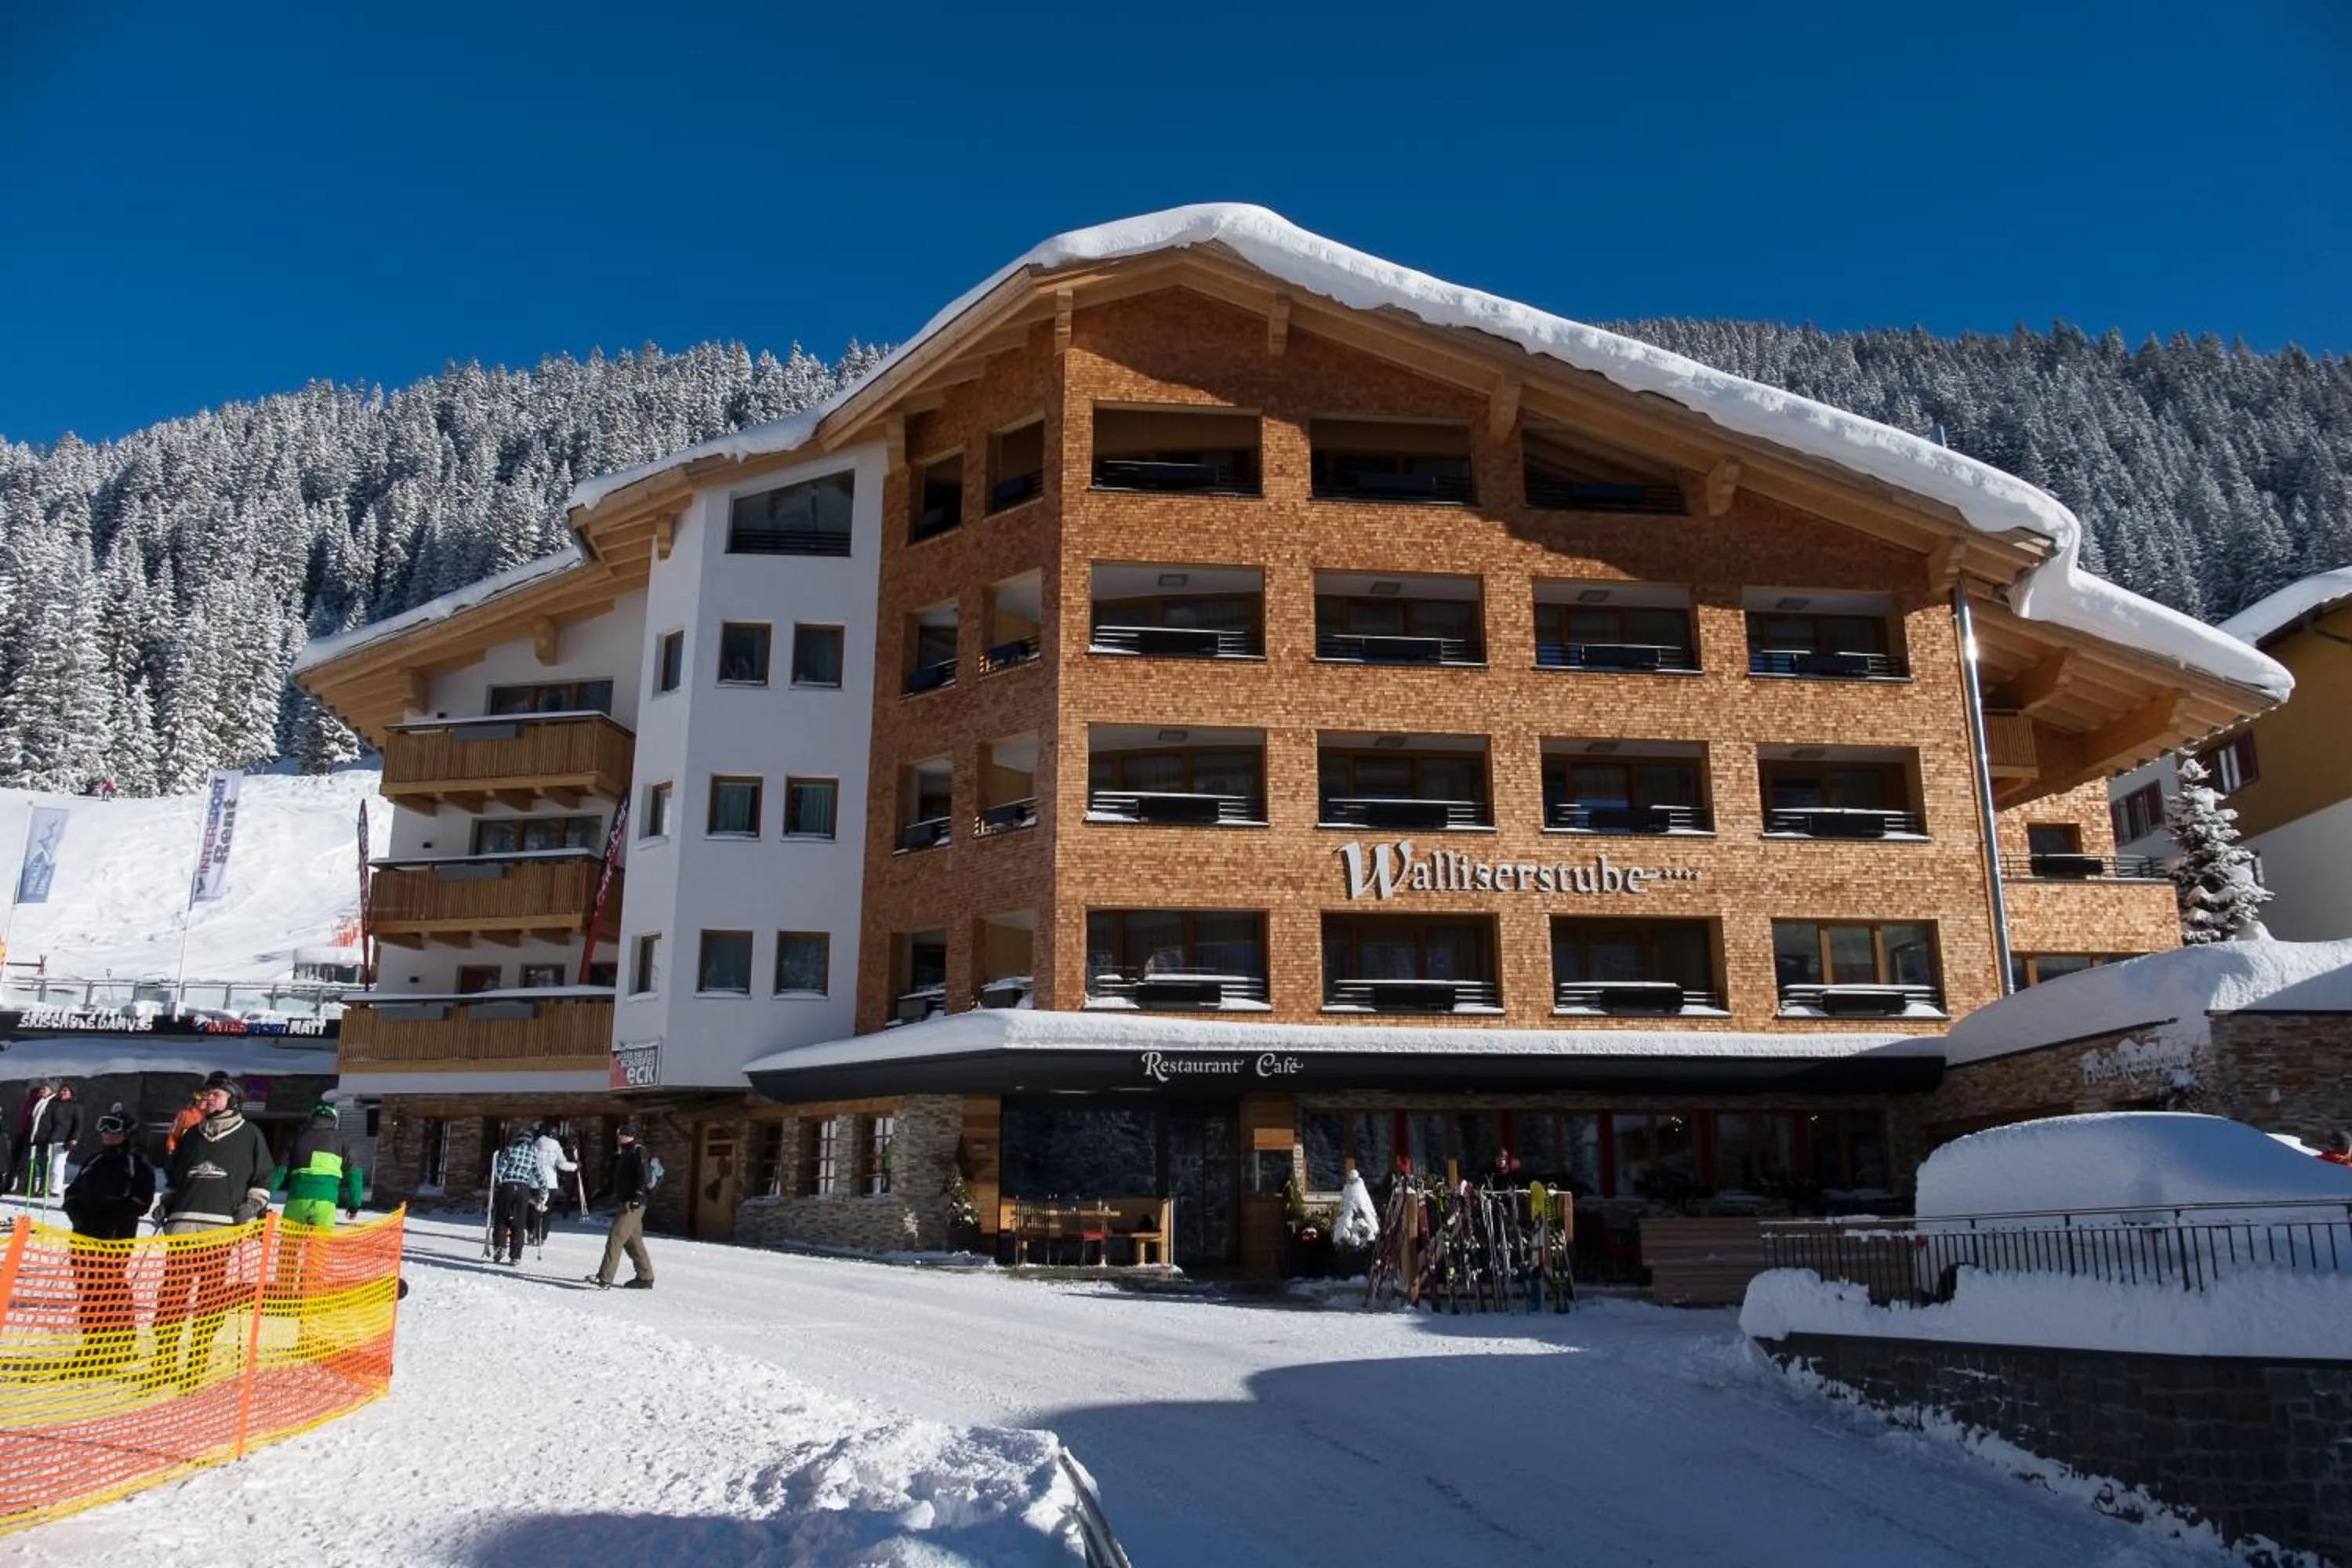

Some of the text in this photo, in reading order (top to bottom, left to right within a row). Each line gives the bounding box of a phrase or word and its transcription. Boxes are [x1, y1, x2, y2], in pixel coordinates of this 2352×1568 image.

[200, 776, 226, 874] INTERSPORT
[213, 798, 237, 863] Rent
[1333, 840, 1656, 901] Walliserstube
[289, 1019, 327, 1036] MATT
[626, 1065, 655, 1085] eck
[1142, 1051, 1304, 1083] Restaurant Café
